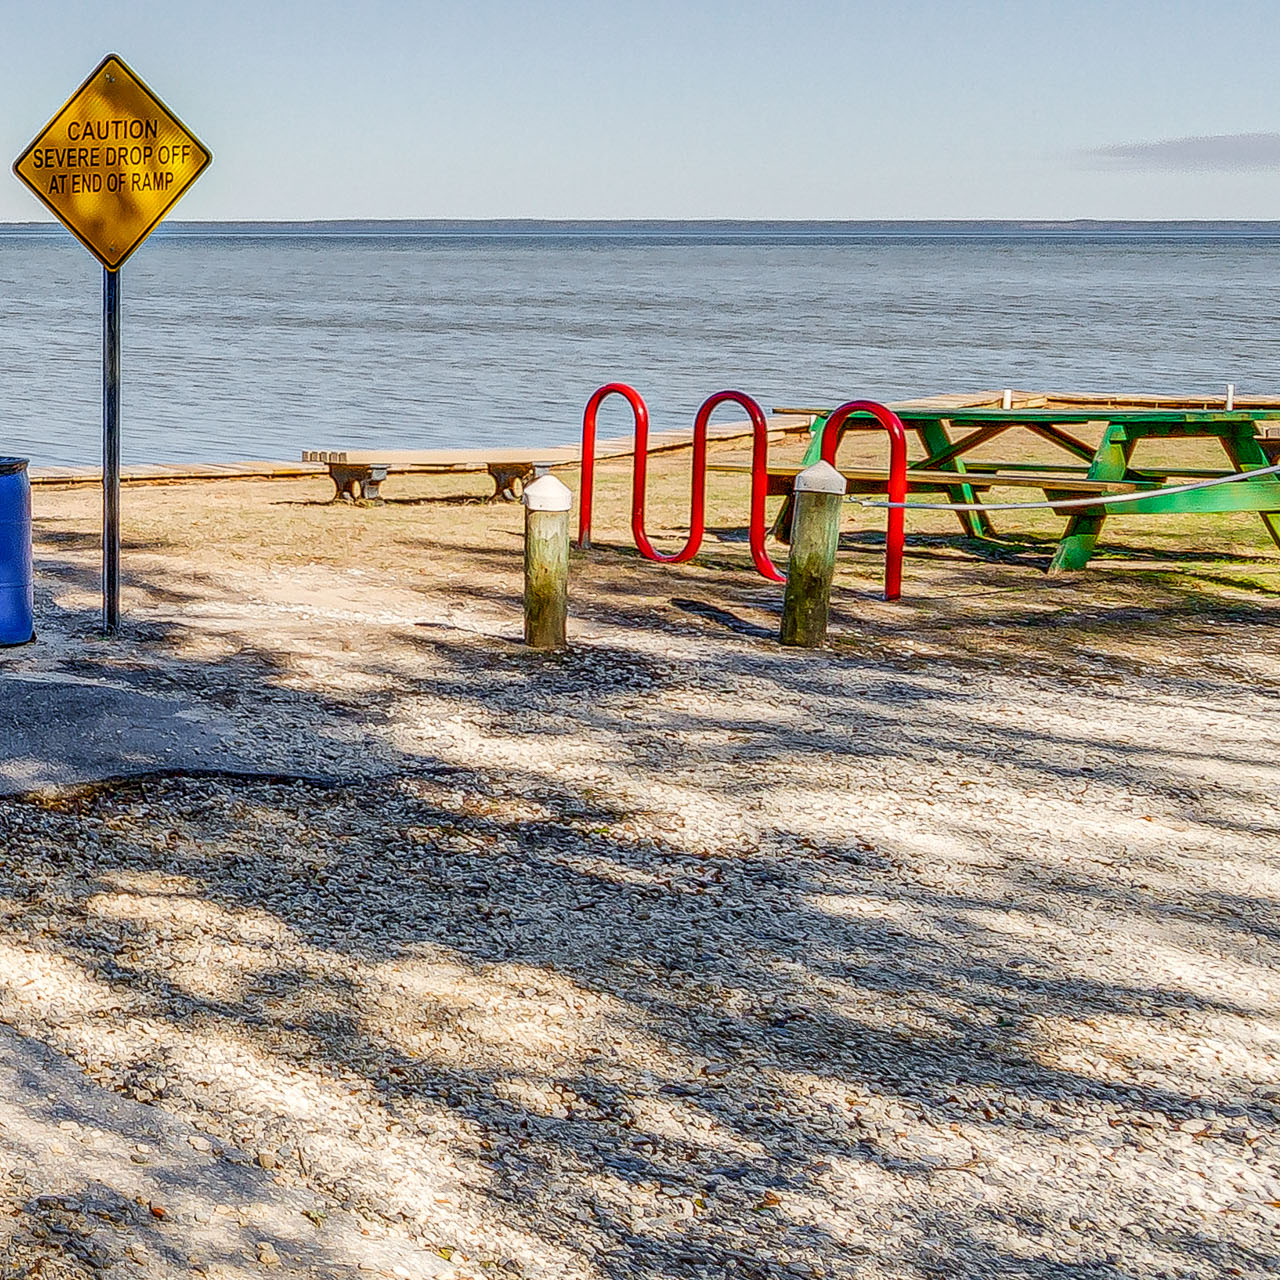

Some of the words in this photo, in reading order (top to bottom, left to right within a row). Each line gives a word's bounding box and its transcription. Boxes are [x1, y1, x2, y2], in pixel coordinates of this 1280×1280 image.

[67, 119, 158, 141] CAUTION
[33, 147, 100, 169] SEVERE
[105, 146, 153, 166] DROP
[158, 145, 191, 165] OFF
[48, 174, 67, 195] AT
[71, 173, 102, 193] END
[107, 173, 127, 193] OF
[131, 171, 174, 192] RAMP
